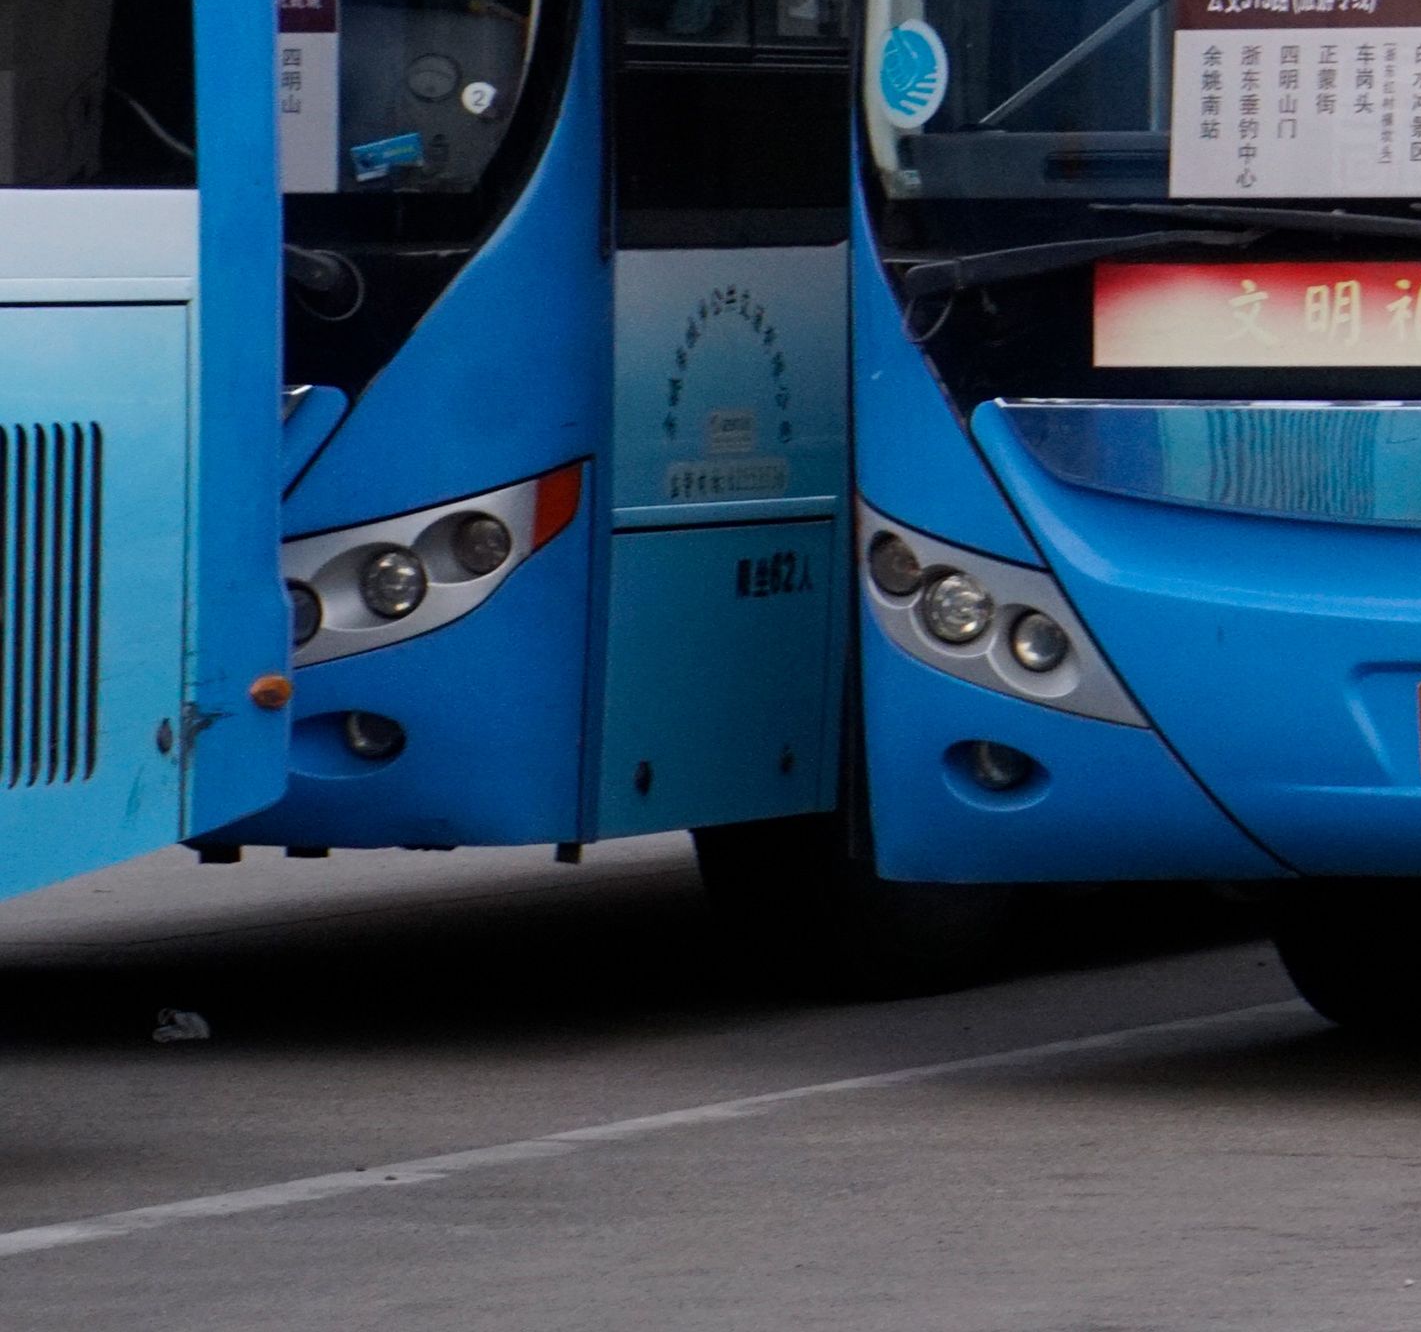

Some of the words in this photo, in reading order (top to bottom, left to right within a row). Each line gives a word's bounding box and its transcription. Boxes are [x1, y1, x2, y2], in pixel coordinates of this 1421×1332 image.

[281, 48, 302, 114] 四明山
[472, 90, 486, 106] 2
[1199, 45, 1224, 141] 余姚南站
[1236, 45, 1262, 189] 浙东垂钓中心
[1276, 44, 1300, 139] 四明山门
[1315, 44, 1338, 115] 正蒙街
